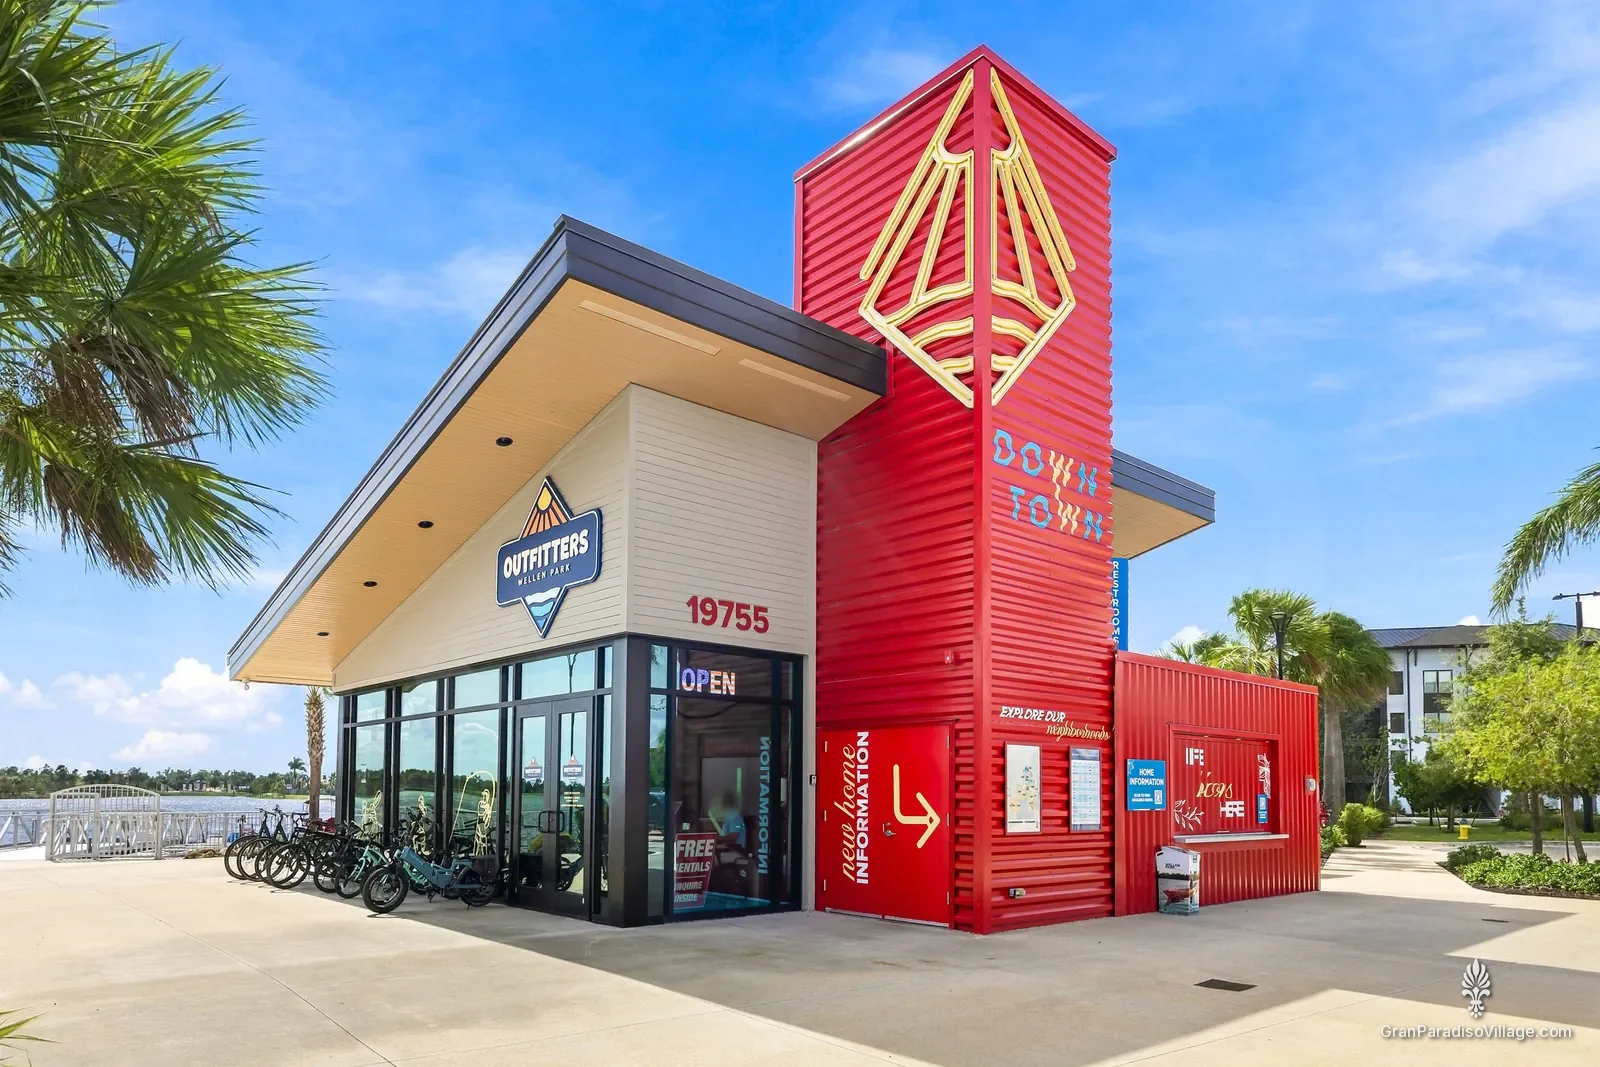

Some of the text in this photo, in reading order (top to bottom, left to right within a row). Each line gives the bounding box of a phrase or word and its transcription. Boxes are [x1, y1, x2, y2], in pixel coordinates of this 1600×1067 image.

[993, 428, 1098, 498] DOWN
[1009, 485, 1103, 543] TOWN
[503, 528, 589, 579] OUTFITTERS
[517, 563, 571, 586] WELLEN PARK
[686, 595, 770, 634] 19755
[681, 667, 736, 695] OPEN
[1000, 705, 1066, 723] EXPLORE OUR
[1129, 777, 1165, 786] INFORMATION
[1139, 768, 1155, 776] HOME
[833, 743, 856, 882] new home
[856, 731, 869, 884] INFORMATION
[1220, 801, 1245, 818] HERE
[676, 839, 715, 858] FREE
